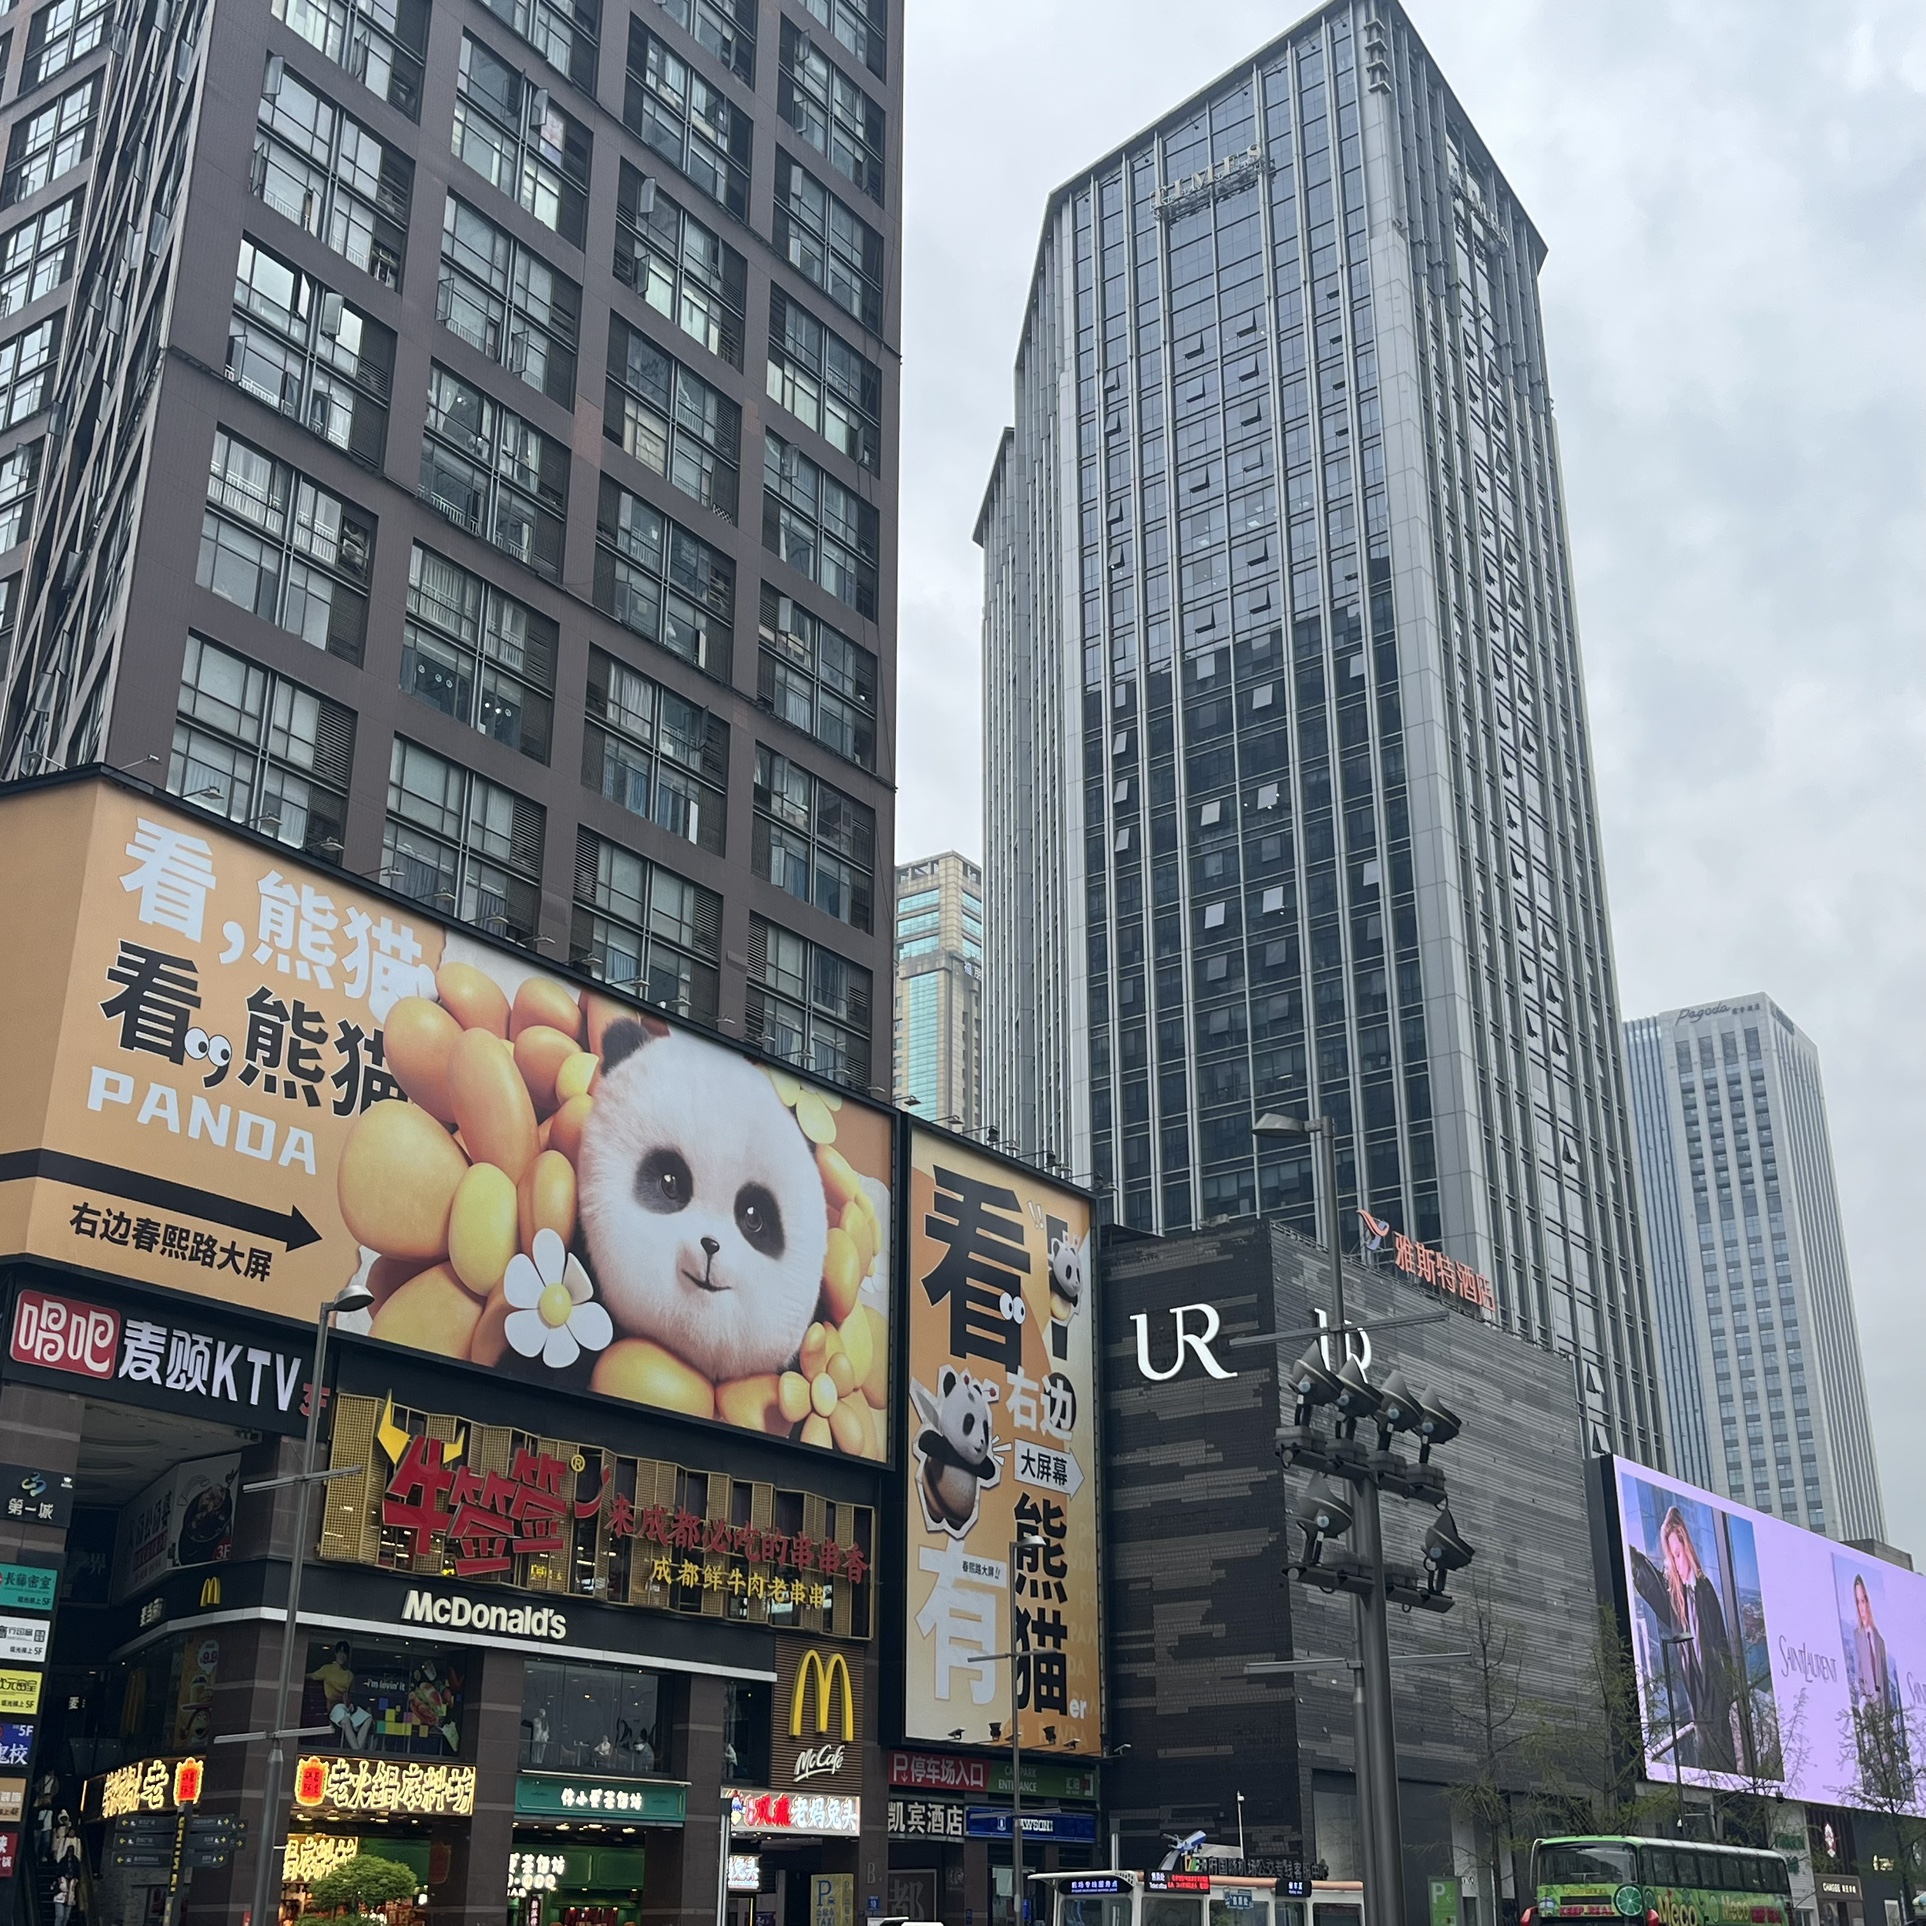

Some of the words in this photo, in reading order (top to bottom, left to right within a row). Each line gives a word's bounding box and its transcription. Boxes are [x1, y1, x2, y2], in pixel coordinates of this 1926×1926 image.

[1674, 1002, 1731, 1026] Pagoda
[86, 1065, 317, 1176] PANDA
[68, 1201, 274, 1284] 右边春熙路大屏
[920, 1163, 1031, 1375] 看
[1392, 1230, 1498, 1313] 雅斯特酒店
[1129, 1302, 1238, 1381] UR
[118, 1318, 302, 1412] 麦颂KTV
[1005, 1364, 1076, 1441] 右边
[1019, 1448, 1069, 1488] 大屏幕
[7, 1497, 55, 1521] 第一城
[604, 1491, 870, 1585] 来成都必吃的串串香
[651, 1556, 826, 1610] 成都鲜牛肉老串串
[1013, 1491, 1069, 1717] 熊猫
[400, 1589, 568, 1640] McDonald's
[914, 1536, 1008, 1706] 有
[18, 1724, 34, 1737] 5F
[1069, 1700, 1088, 1719] er
[793, 1744, 846, 1780] McCafé
[910, 1756, 984, 1788] 停车场入口
[887, 1800, 964, 1837] 凯宾酒店
[817, 1879, 833, 1907] P
[1431, 1881, 1447, 1905] P
[1657, 1894, 1699, 1926] Meco
[1722, 1895, 1750, 1920] Meco
